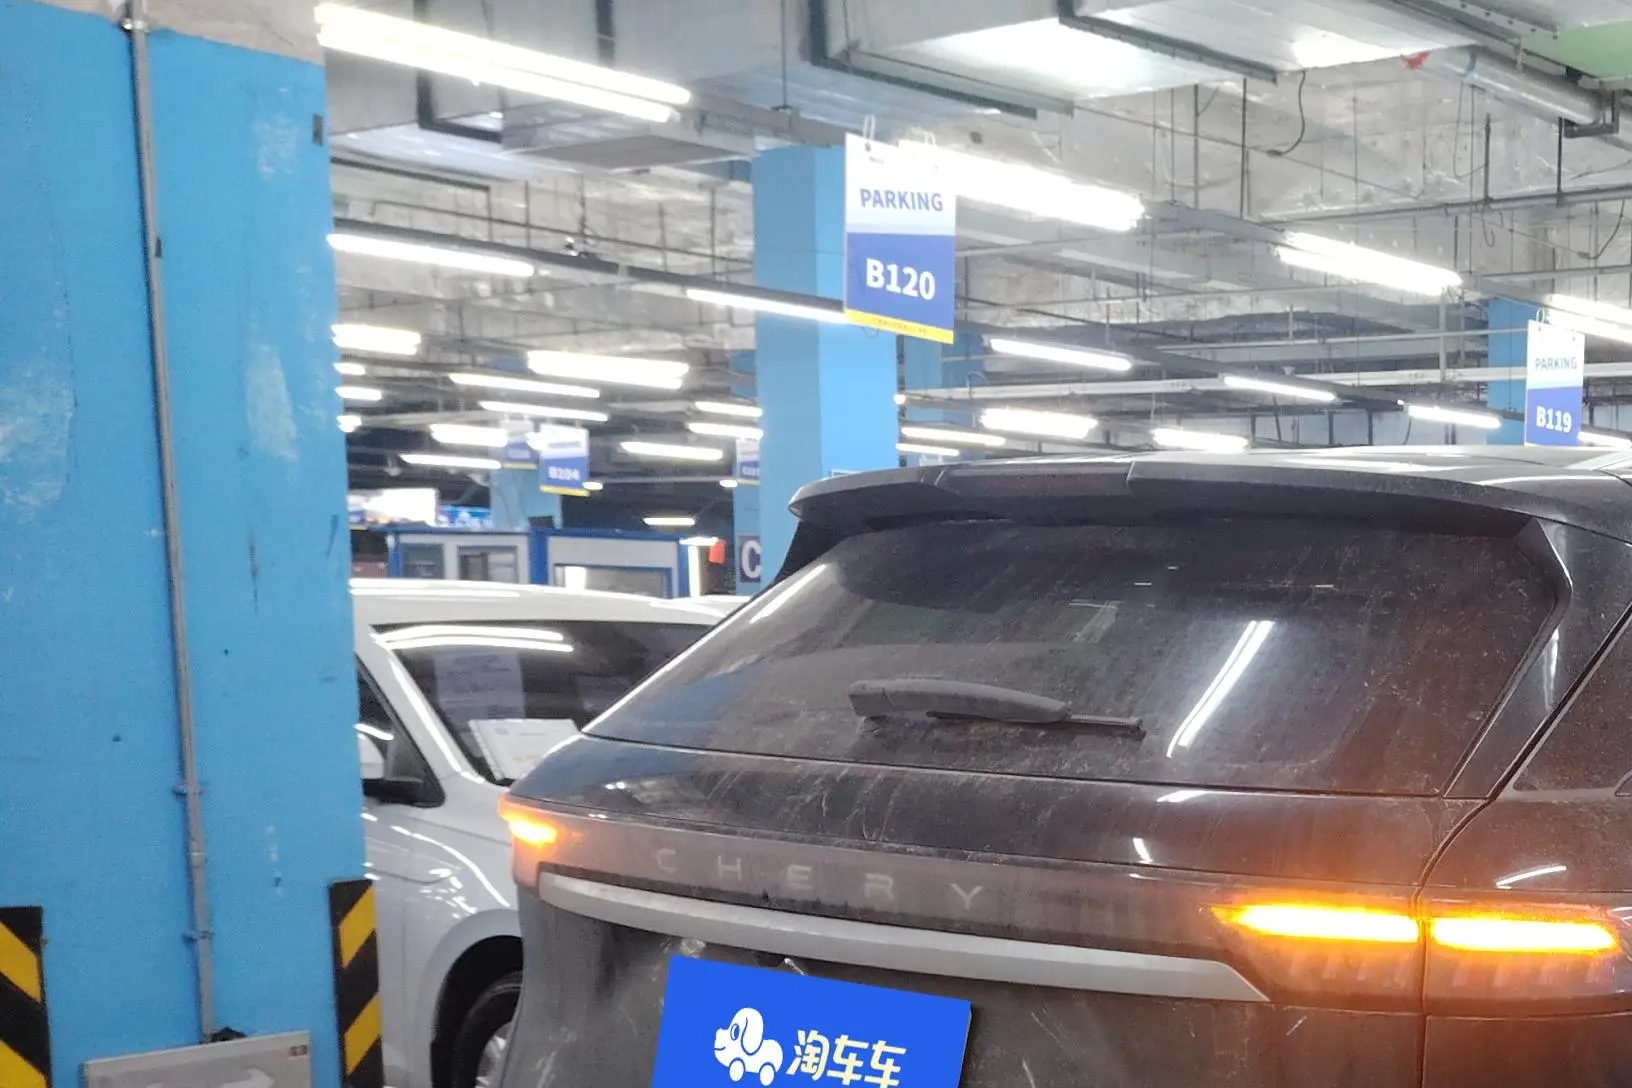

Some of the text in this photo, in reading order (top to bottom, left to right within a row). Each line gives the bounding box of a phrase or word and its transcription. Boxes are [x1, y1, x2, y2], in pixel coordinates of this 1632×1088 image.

[859, 188, 943, 212] PARKING
[866, 257, 935, 301] B120
[1535, 357, 1578, 371] PARKING
[1536, 405, 1573, 433] B119
[741, 540, 761, 579] C
[655, 848, 983, 911] CHERY
